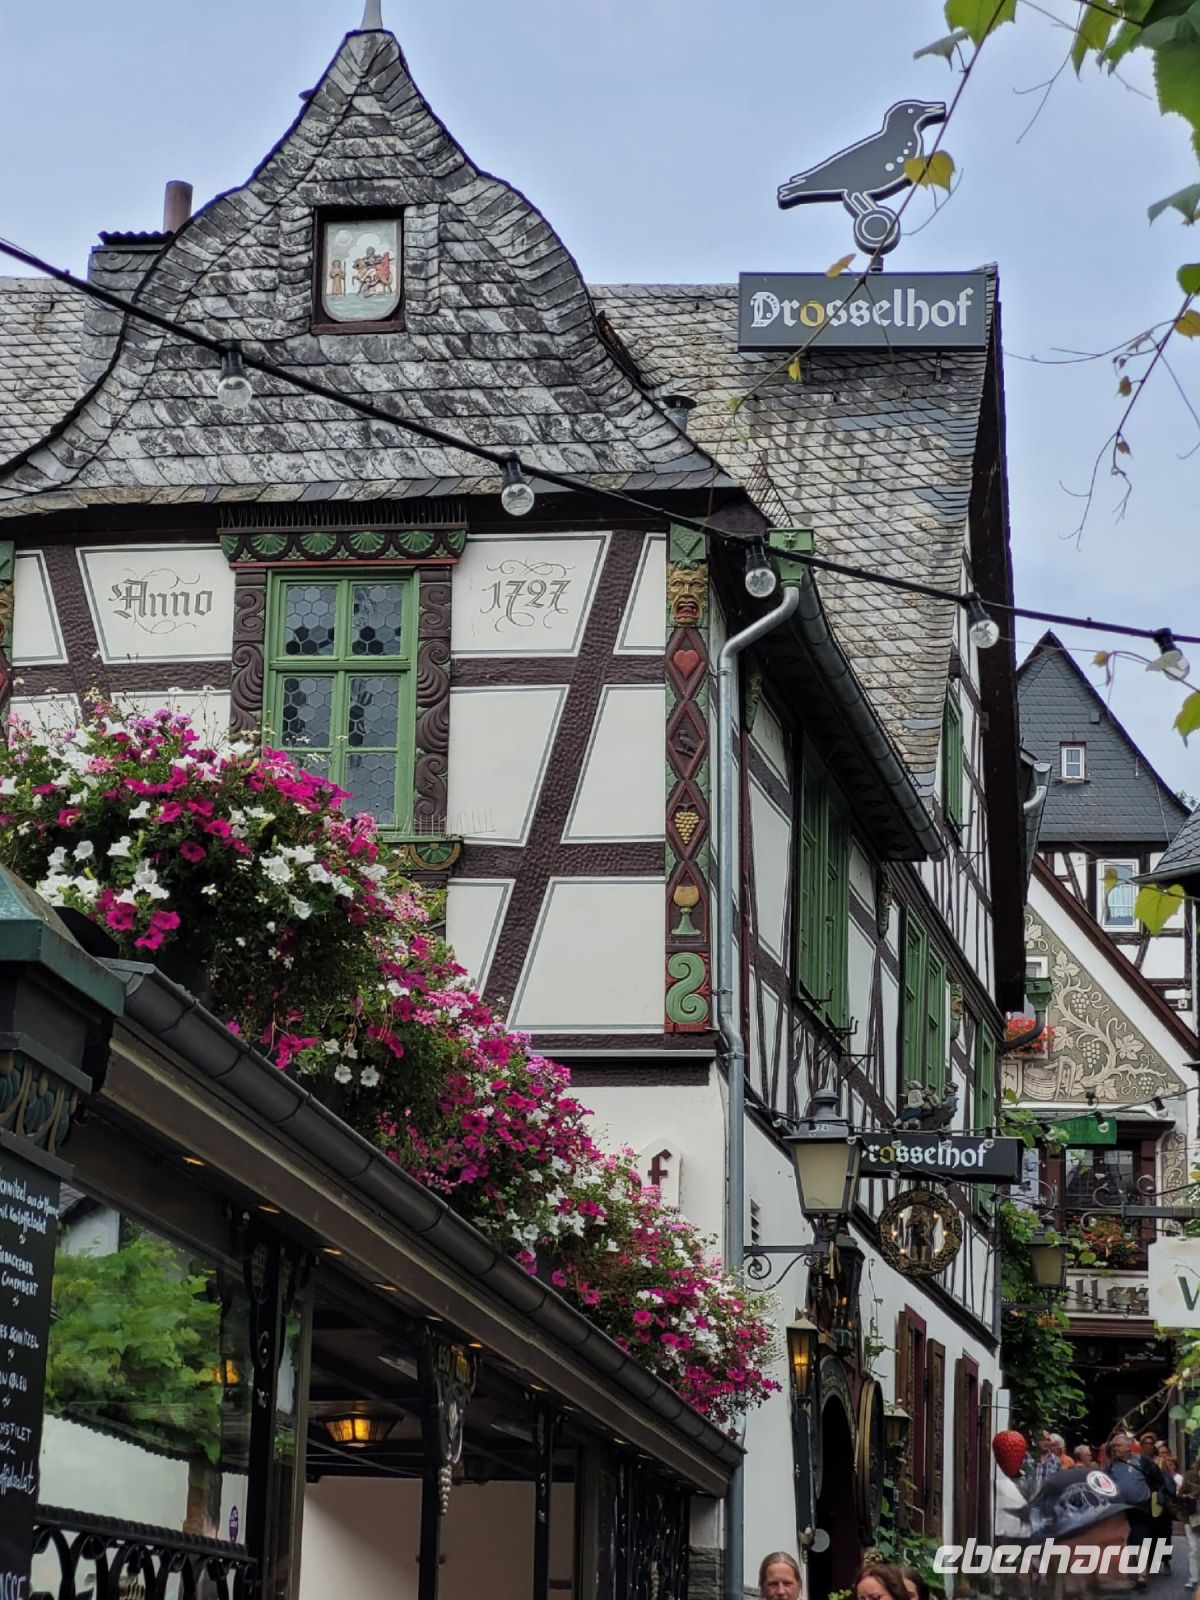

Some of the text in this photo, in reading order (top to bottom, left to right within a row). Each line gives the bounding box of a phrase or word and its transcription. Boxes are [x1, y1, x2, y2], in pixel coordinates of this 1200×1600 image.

[750, 287, 974, 331] Drosselhof
[108, 578, 213, 619] Anno
[861, 1143, 987, 1169] rosselhof
